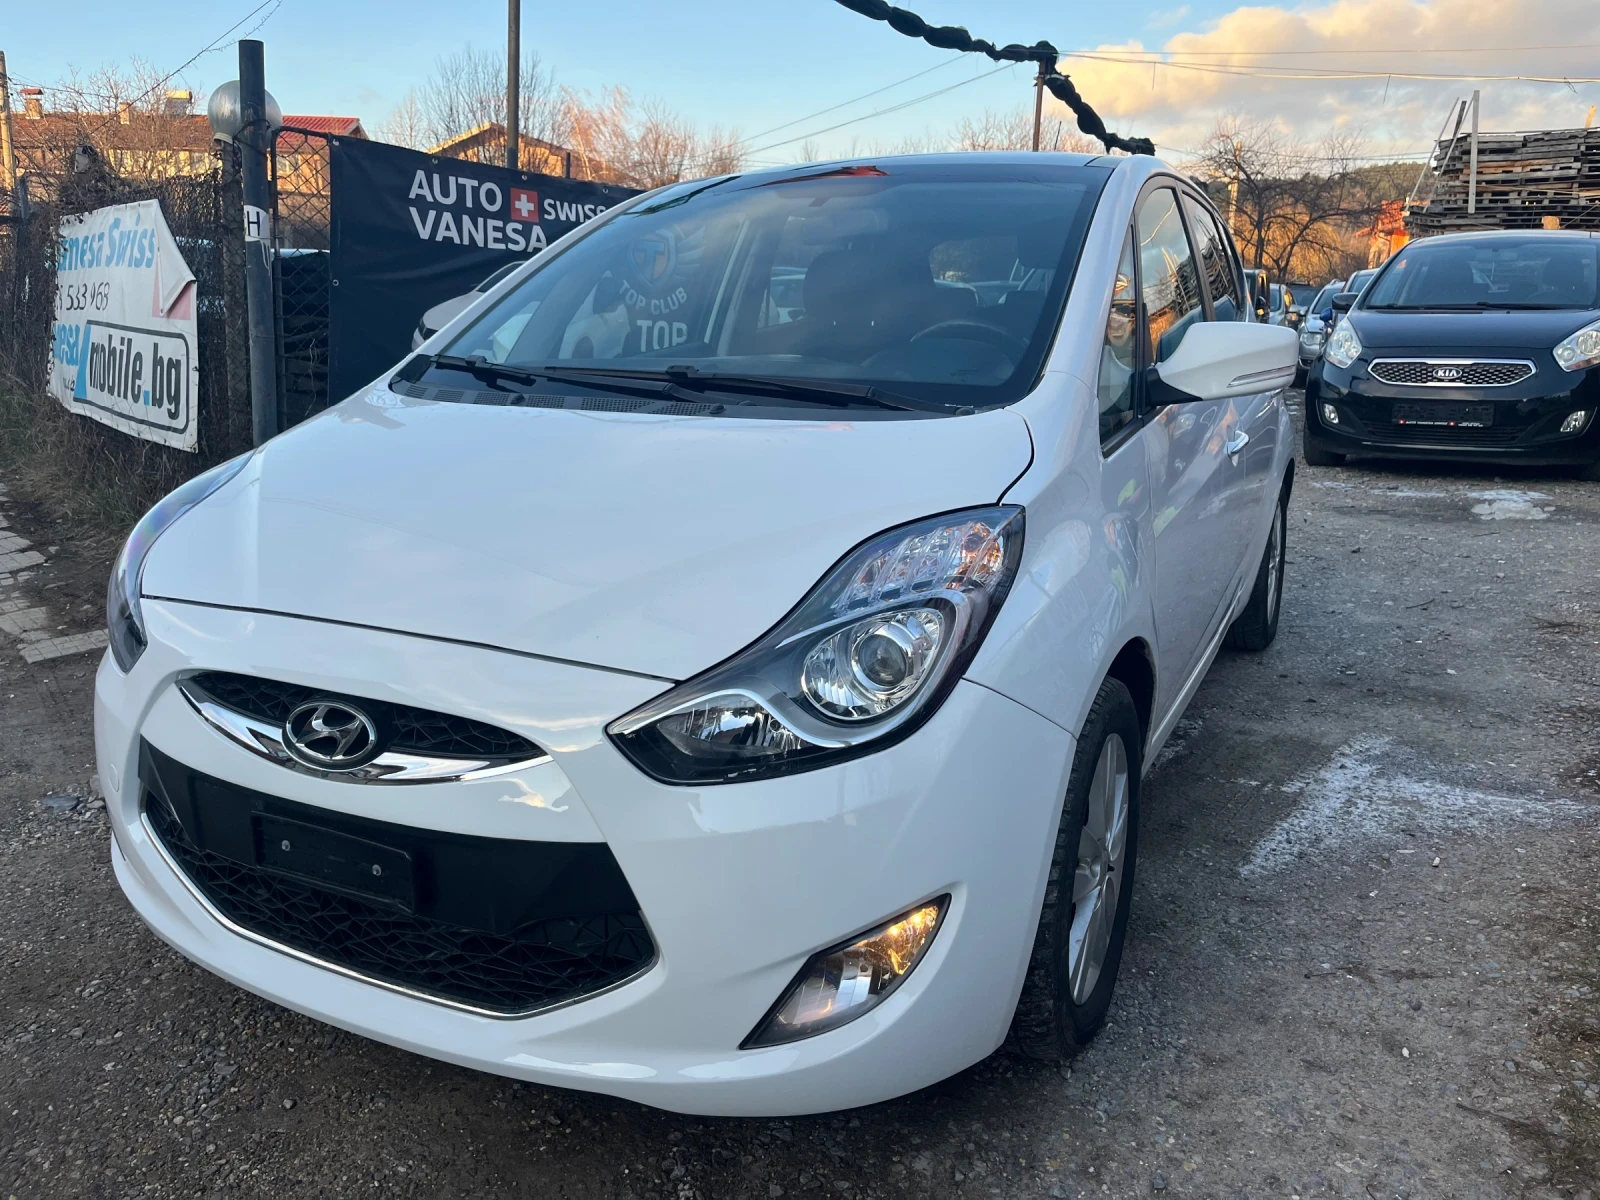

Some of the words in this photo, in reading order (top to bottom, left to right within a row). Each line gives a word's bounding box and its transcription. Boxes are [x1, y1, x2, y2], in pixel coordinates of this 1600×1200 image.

[408, 169, 503, 212] AUTO
[105, 213, 156, 269] Swiss
[408, 206, 548, 253] VANESA
[618, 279, 646, 311] TOP
[650, 286, 688, 315] CLUB
[636, 319, 688, 352] TOP
[89, 333, 182, 420] mobile.bg
[1437, 369, 1458, 377] KIA
